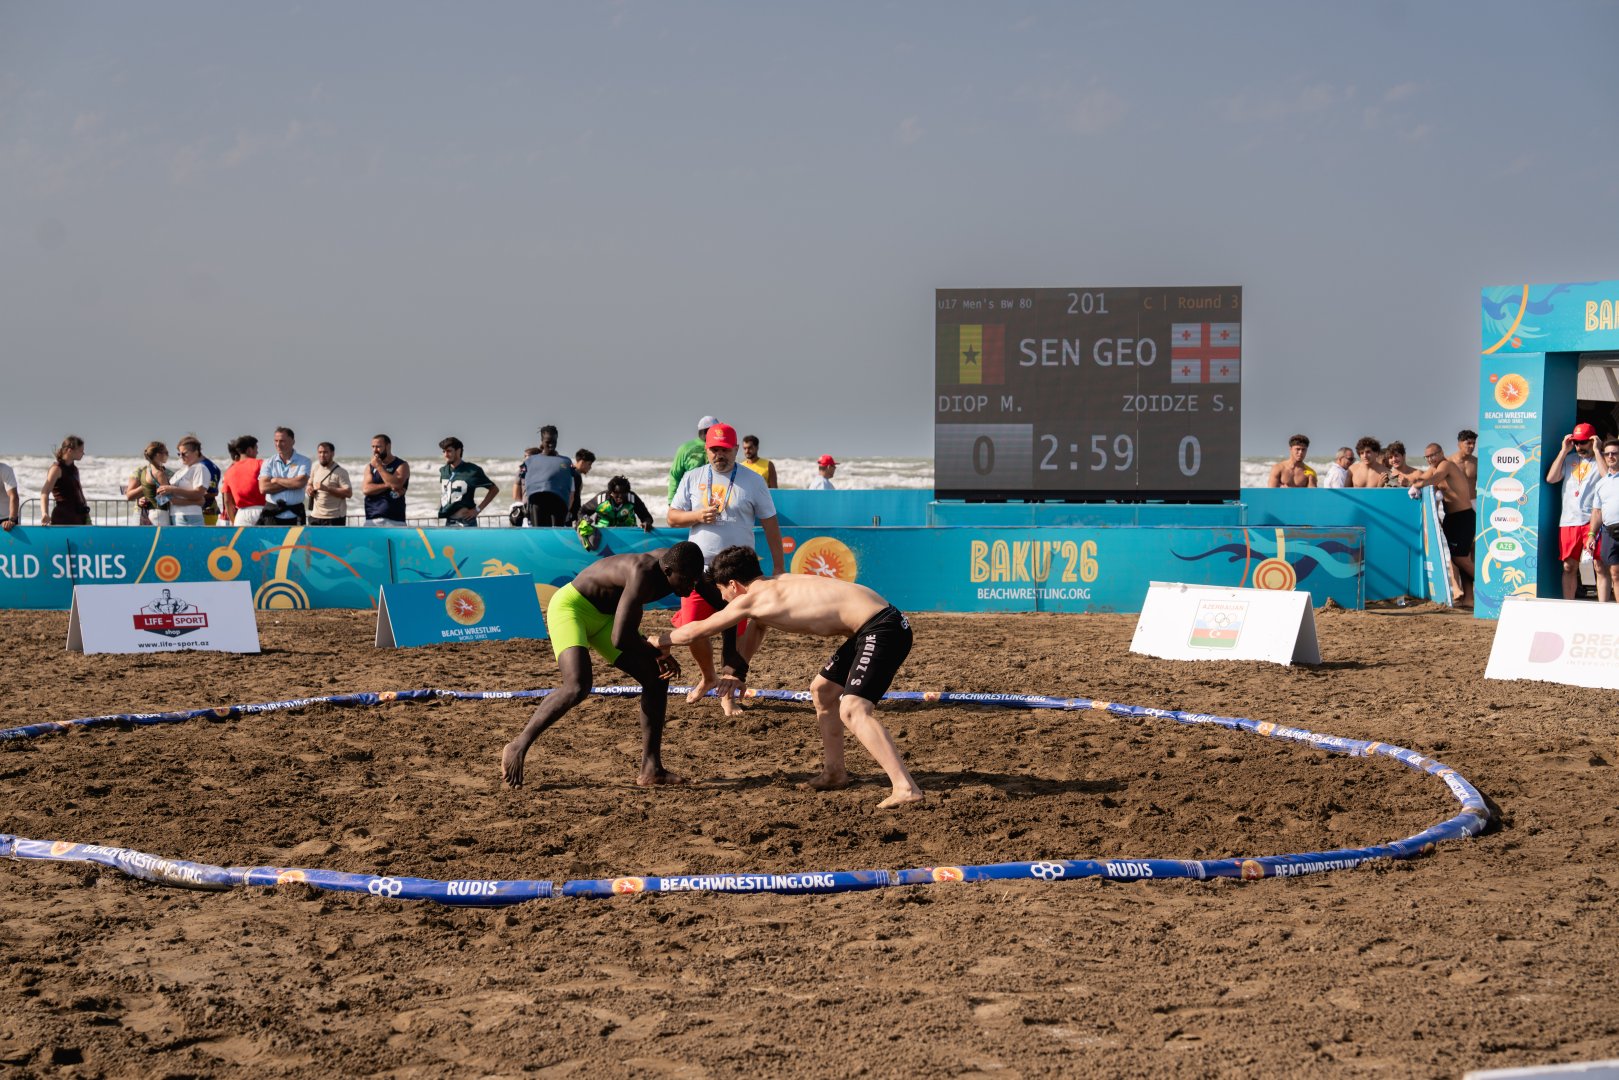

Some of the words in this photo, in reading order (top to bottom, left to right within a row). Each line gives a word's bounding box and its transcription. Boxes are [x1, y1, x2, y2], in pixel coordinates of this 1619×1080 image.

[938, 298, 957, 309] U17
[962, 298, 994, 309] Men's
[1001, 299, 1014, 309] BW
[1019, 298, 1032, 309] 80
[1067, 292, 1109, 315] 201
[1178, 294, 1222, 310] Round
[1231, 294, 1239, 309] 3
[1018, 338, 1081, 367] SEN
[1093, 337, 1157, 367] GEO
[938, 395, 988, 412] DIOP
[1000, 396, 1023, 413] M.
[1122, 395, 1199, 412] ZOIDZE
[1212, 395, 1235, 412] S.
[1485, 411, 1503, 419] BEACH
[1504, 411, 1537, 419] WRESTLING
[972, 435, 995, 476] 0
[1039, 434, 1134, 471] 2:59
[1178, 435, 1201, 477] 0
[1497, 456, 1520, 465] RUDIS
[52, 554, 127, 579] SERIES
[970, 539, 1099, 583] BAKU'26
[977, 588, 1091, 600] BEACHWRESTLING.ORG
[144, 617, 163, 626] LIFE
[175, 616, 204, 625] SPORT
[441, 629, 463, 638] BEACH
[464, 625, 502, 635] WRESTLING
[138, 640, 209, 649] www.life-sport.az
[482, 691, 512, 699] RUDIS
[949, 693, 1046, 701] BEACHWRESTLING.ORG
[1106, 862, 1153, 878] RUDIS
[447, 881, 498, 896] RUDIS
[660, 873, 835, 892] BEACHWRESTLING.ORG
